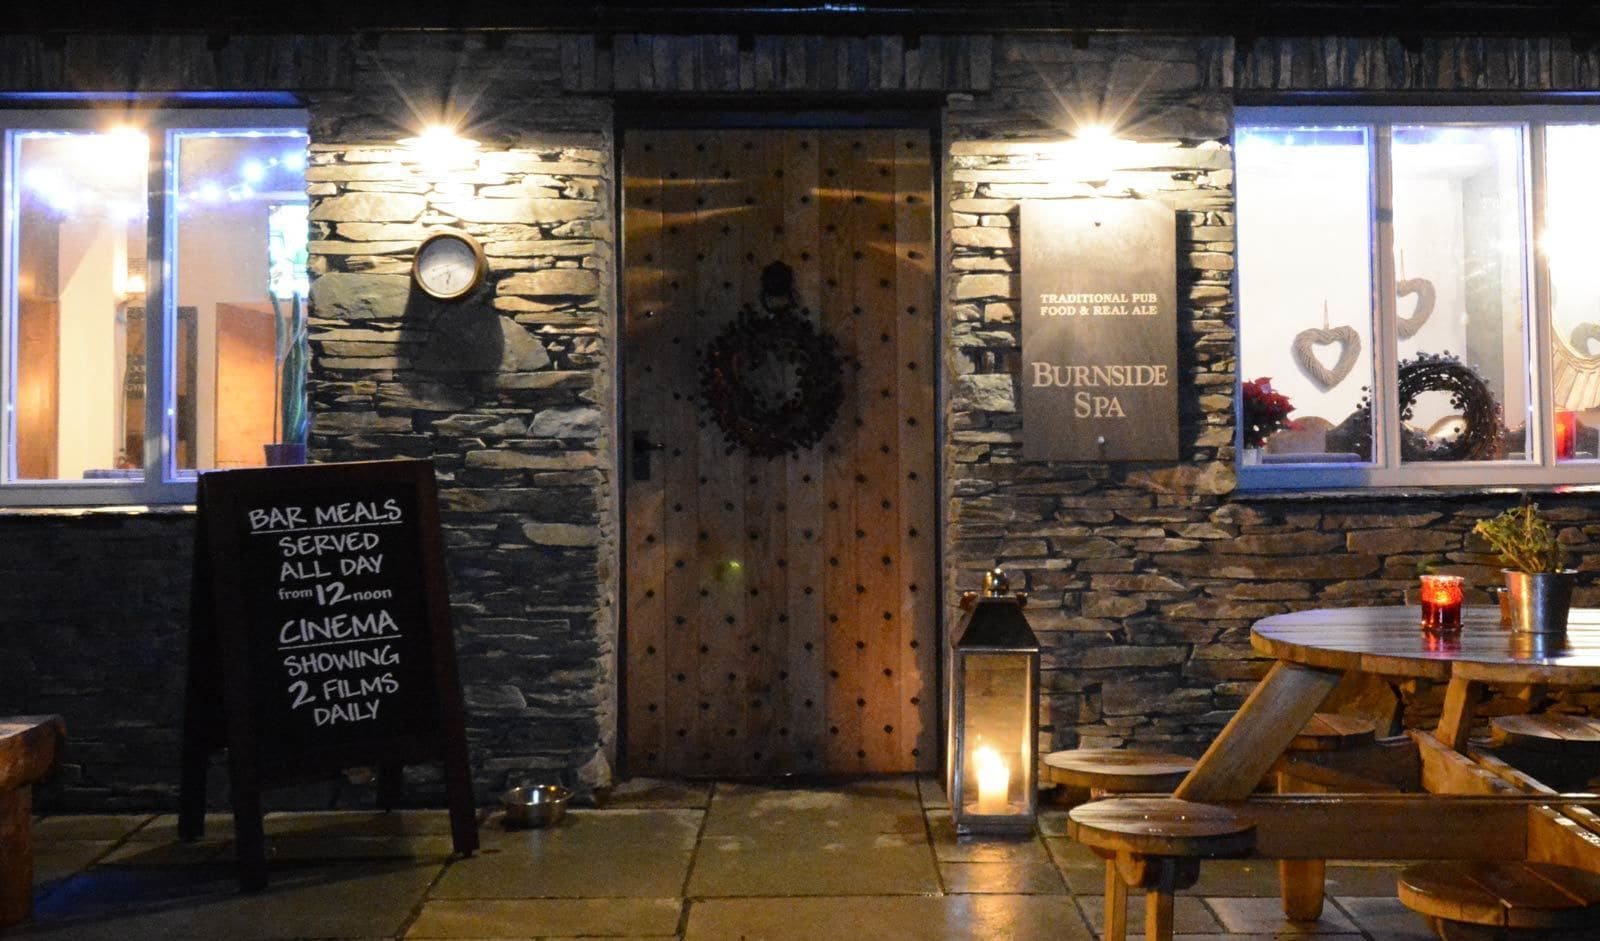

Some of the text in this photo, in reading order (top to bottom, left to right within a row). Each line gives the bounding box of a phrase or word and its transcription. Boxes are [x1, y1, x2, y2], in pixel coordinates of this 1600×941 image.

[1040, 293, 1158, 304] TRADITIONAL PUB
[1040, 305, 1158, 316] FOOD & REAL ALE
[1031, 362, 1168, 387] BURNSIDE
[1074, 392, 1126, 418] SPA
[249, 499, 402, 529] BAR MEALS
[279, 532, 379, 556] SERVED
[280, 554, 383, 581] ALL DAY
[278, 581, 393, 606] from 12 noon
[280, 610, 399, 643] CINEMA
[283, 645, 400, 676] SHOWING
[288, 673, 399, 709] 2 FILMS
[313, 699, 379, 726] DAILY
